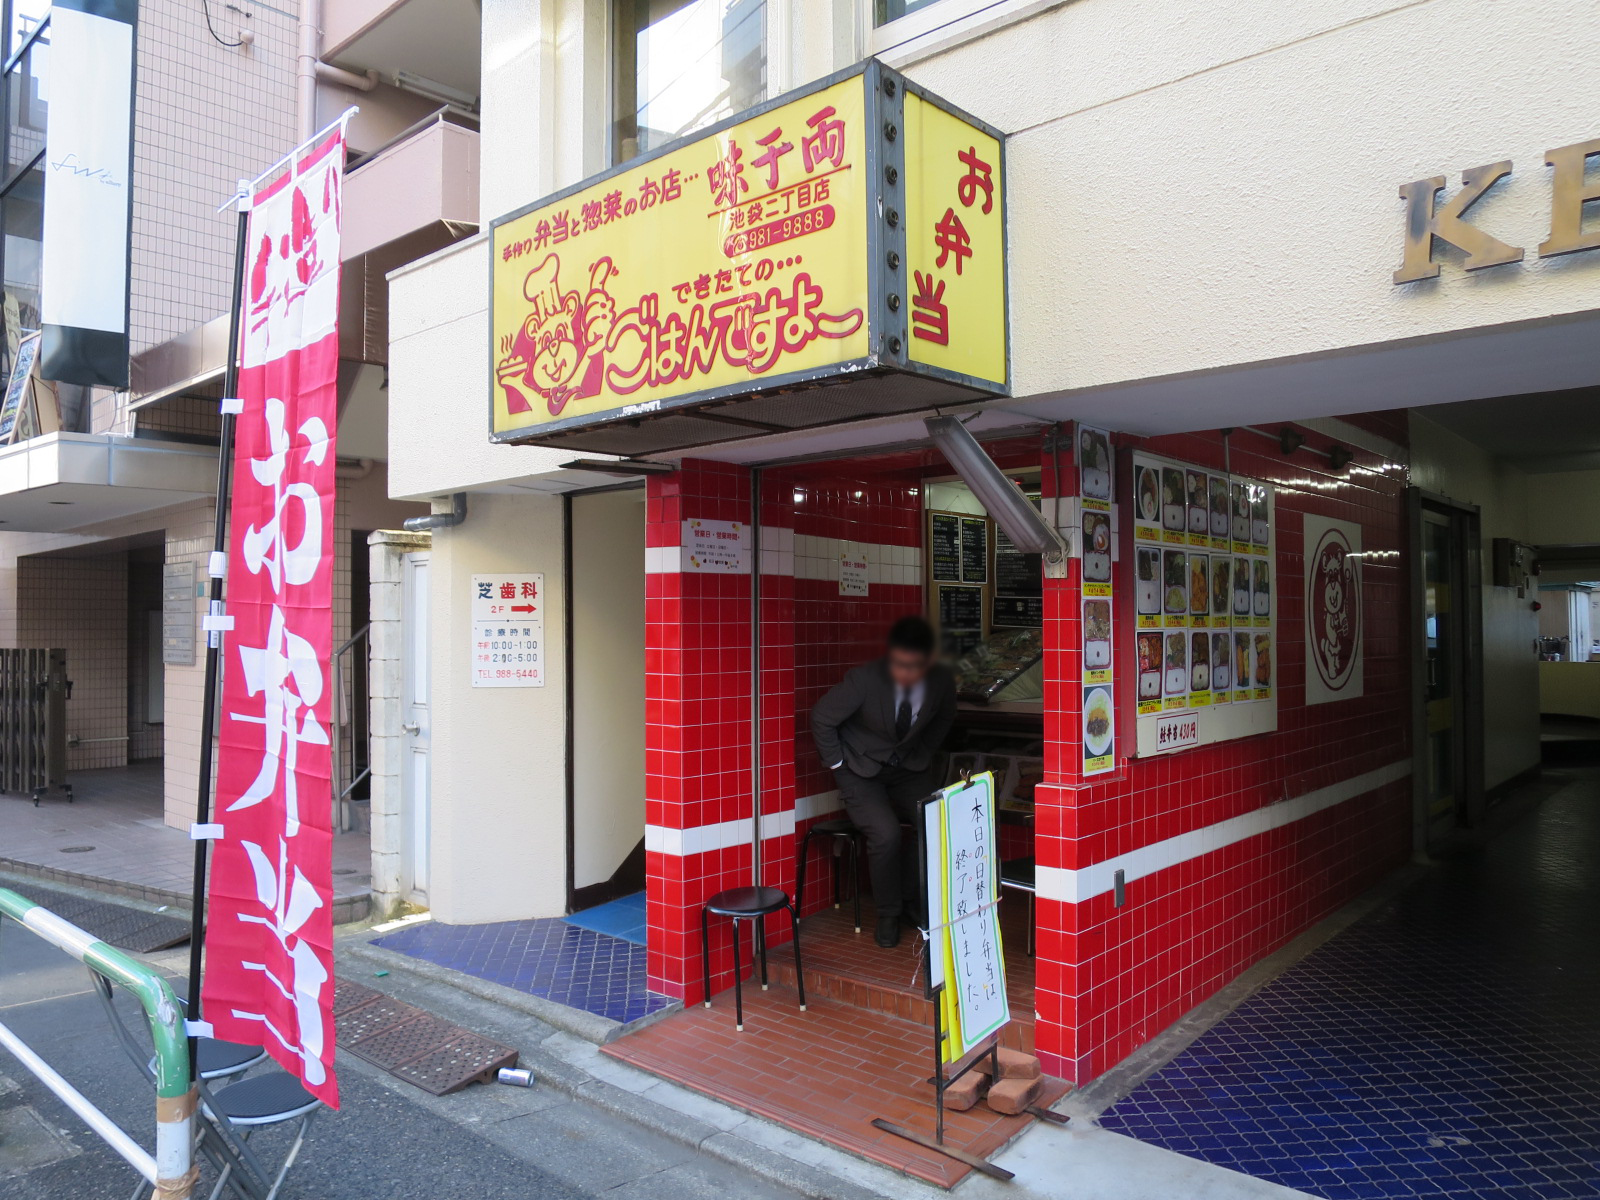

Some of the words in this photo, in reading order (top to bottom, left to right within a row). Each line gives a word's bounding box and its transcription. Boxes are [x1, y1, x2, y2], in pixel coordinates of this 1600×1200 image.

[707, 105, 846, 207] 味千両
[729, 178, 830, 231] 池袋二丁目店
[912, 145, 994, 347] お弁当
[490, 605, 505, 614] 2F
[495, 669, 538, 678] 988-5440
[225, 398, 330, 1086] お弁当
